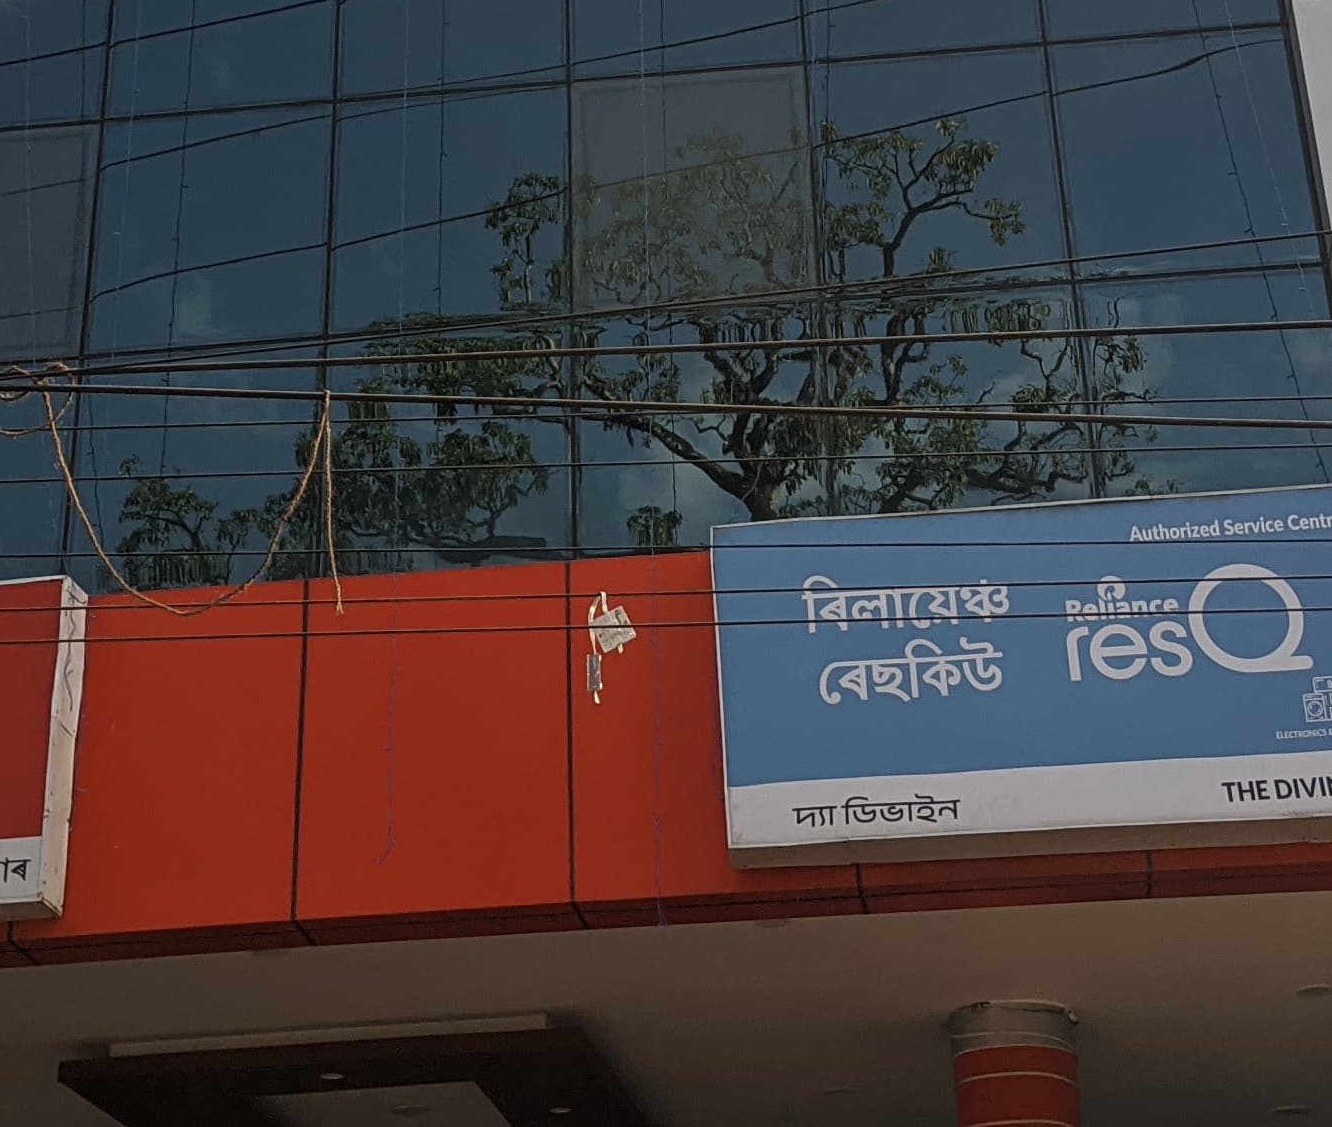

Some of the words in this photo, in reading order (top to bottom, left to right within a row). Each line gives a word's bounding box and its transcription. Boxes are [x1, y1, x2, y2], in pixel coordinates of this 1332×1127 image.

[1129, 519, 1221, 542] Authorized
[1223, 516, 1284, 535] Service
[1065, 585, 1179, 622] Reliance
[1066, 563, 1314, 681] resQ
[1222, 779, 1271, 803] THE
[841, 793, 961, 825] ডিভাইন
